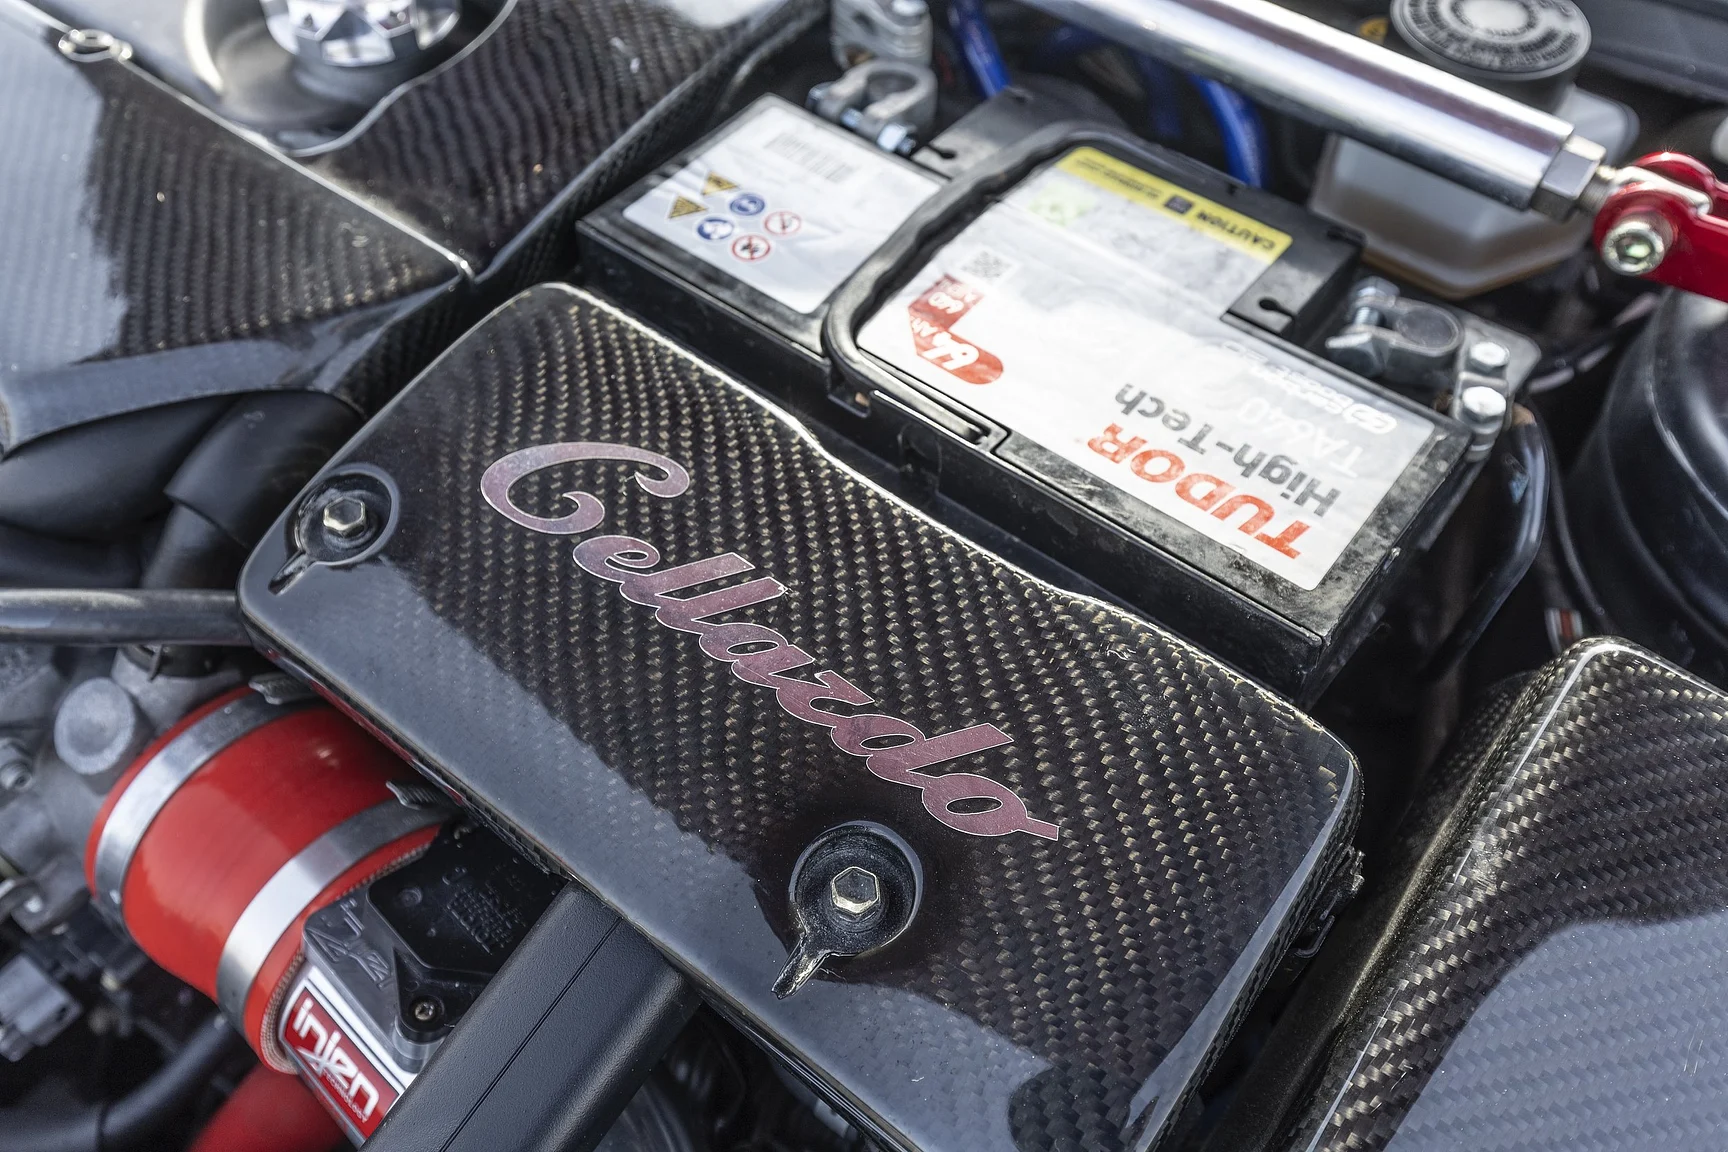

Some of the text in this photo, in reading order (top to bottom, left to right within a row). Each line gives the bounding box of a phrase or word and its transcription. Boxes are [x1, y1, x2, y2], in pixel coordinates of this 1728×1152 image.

[1196, 209, 1277, 252] CAUTION
[921, 330, 980, 371] 64
[1115, 383, 1342, 518] High-Tech
[1236, 396, 1358, 479] TA640
[1088, 423, 1311, 560] TUDOR
[292, 997, 380, 1119] injen
